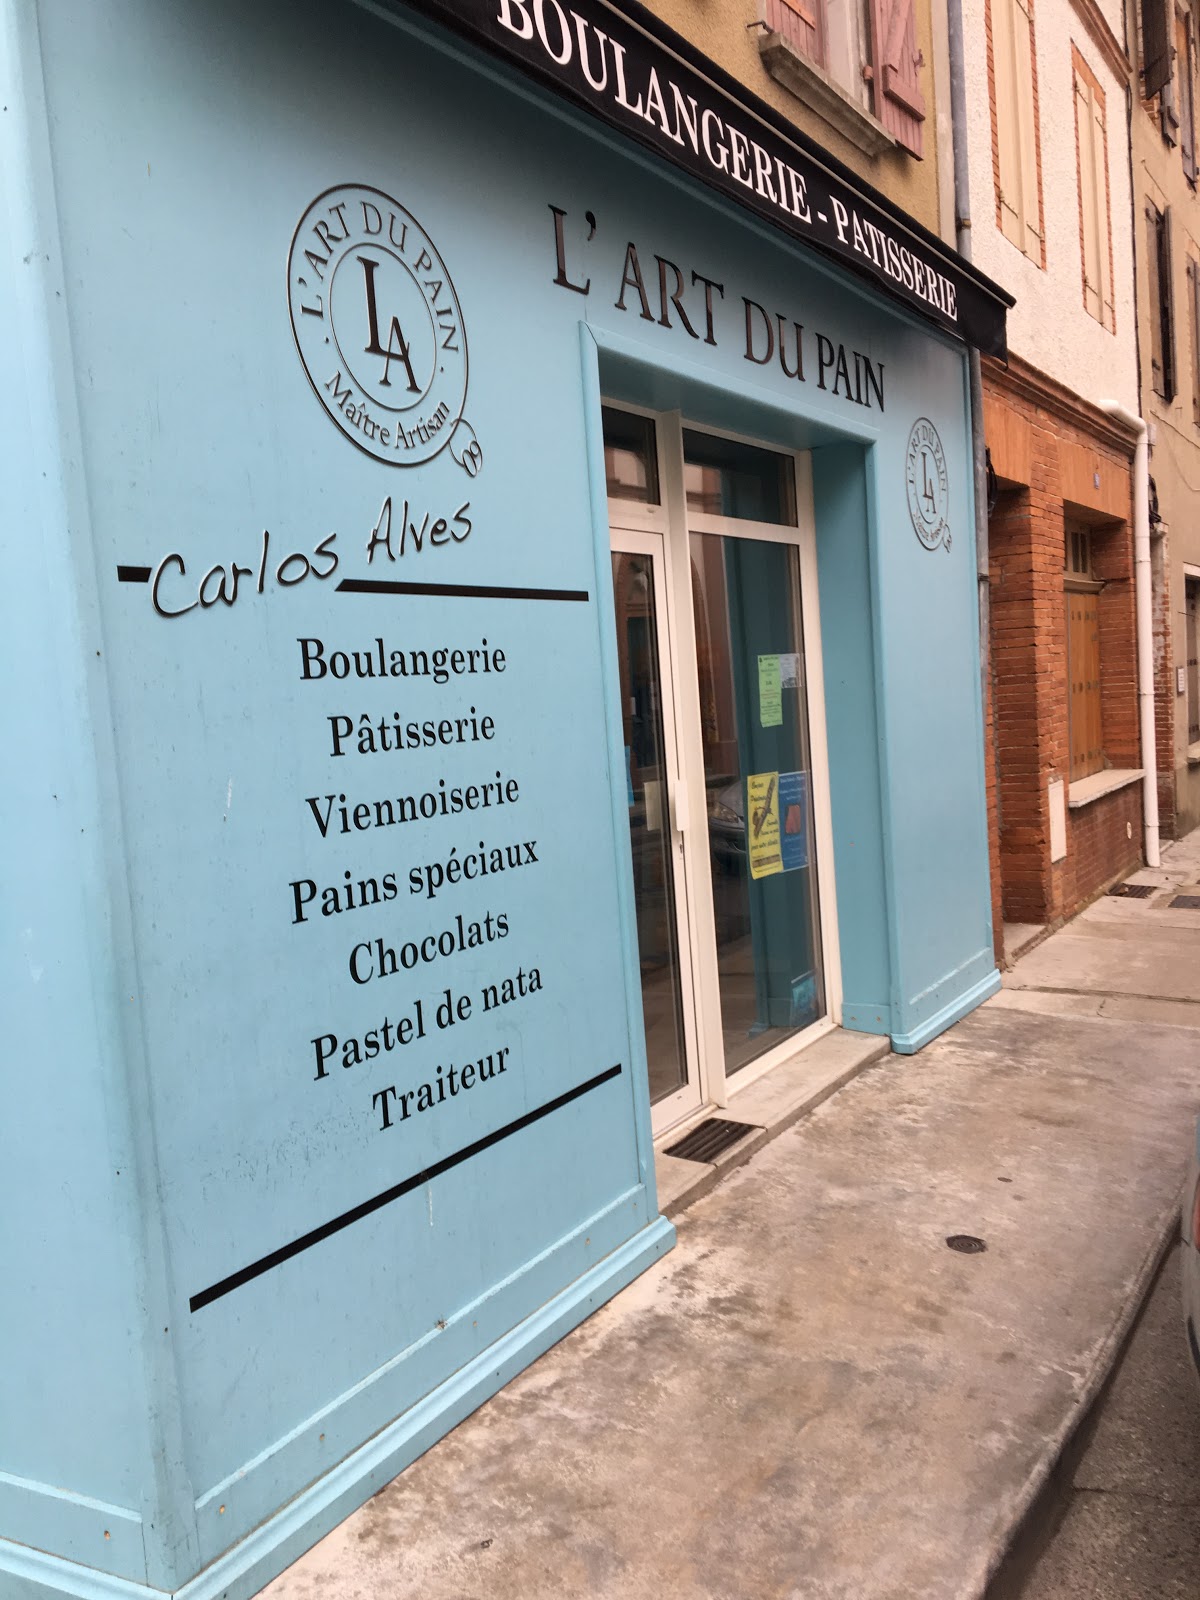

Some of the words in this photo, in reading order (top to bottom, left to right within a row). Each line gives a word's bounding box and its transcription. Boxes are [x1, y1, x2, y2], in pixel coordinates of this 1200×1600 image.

[360, 200, 408, 253] DU
[413, 247, 459, 352] PAIN
[829, 195, 958, 321] PATISSERIE
[742, 296, 804, 381] DU
[816, 332, 885, 412] PAIN
[324, 370, 390, 446] Maître
[394, 400, 450, 450] Artisan
[152, 530, 339, 618] Carlos
[366, 496, 473, 564] Alves
[297, 638, 507, 684] Boulangerie
[327, 706, 496, 757] Pâtisserie
[305, 771, 519, 838] Viennoiserie
[289, 870, 399, 924] Pains
[408, 840, 540, 899] spéciaux
[349, 911, 510, 985] Chocolats
[311, 1000, 427, 1081] Pastel
[436, 989, 473, 1030] de
[481, 966, 544, 1012] nata
[372, 1047, 510, 1131] Traiteur
